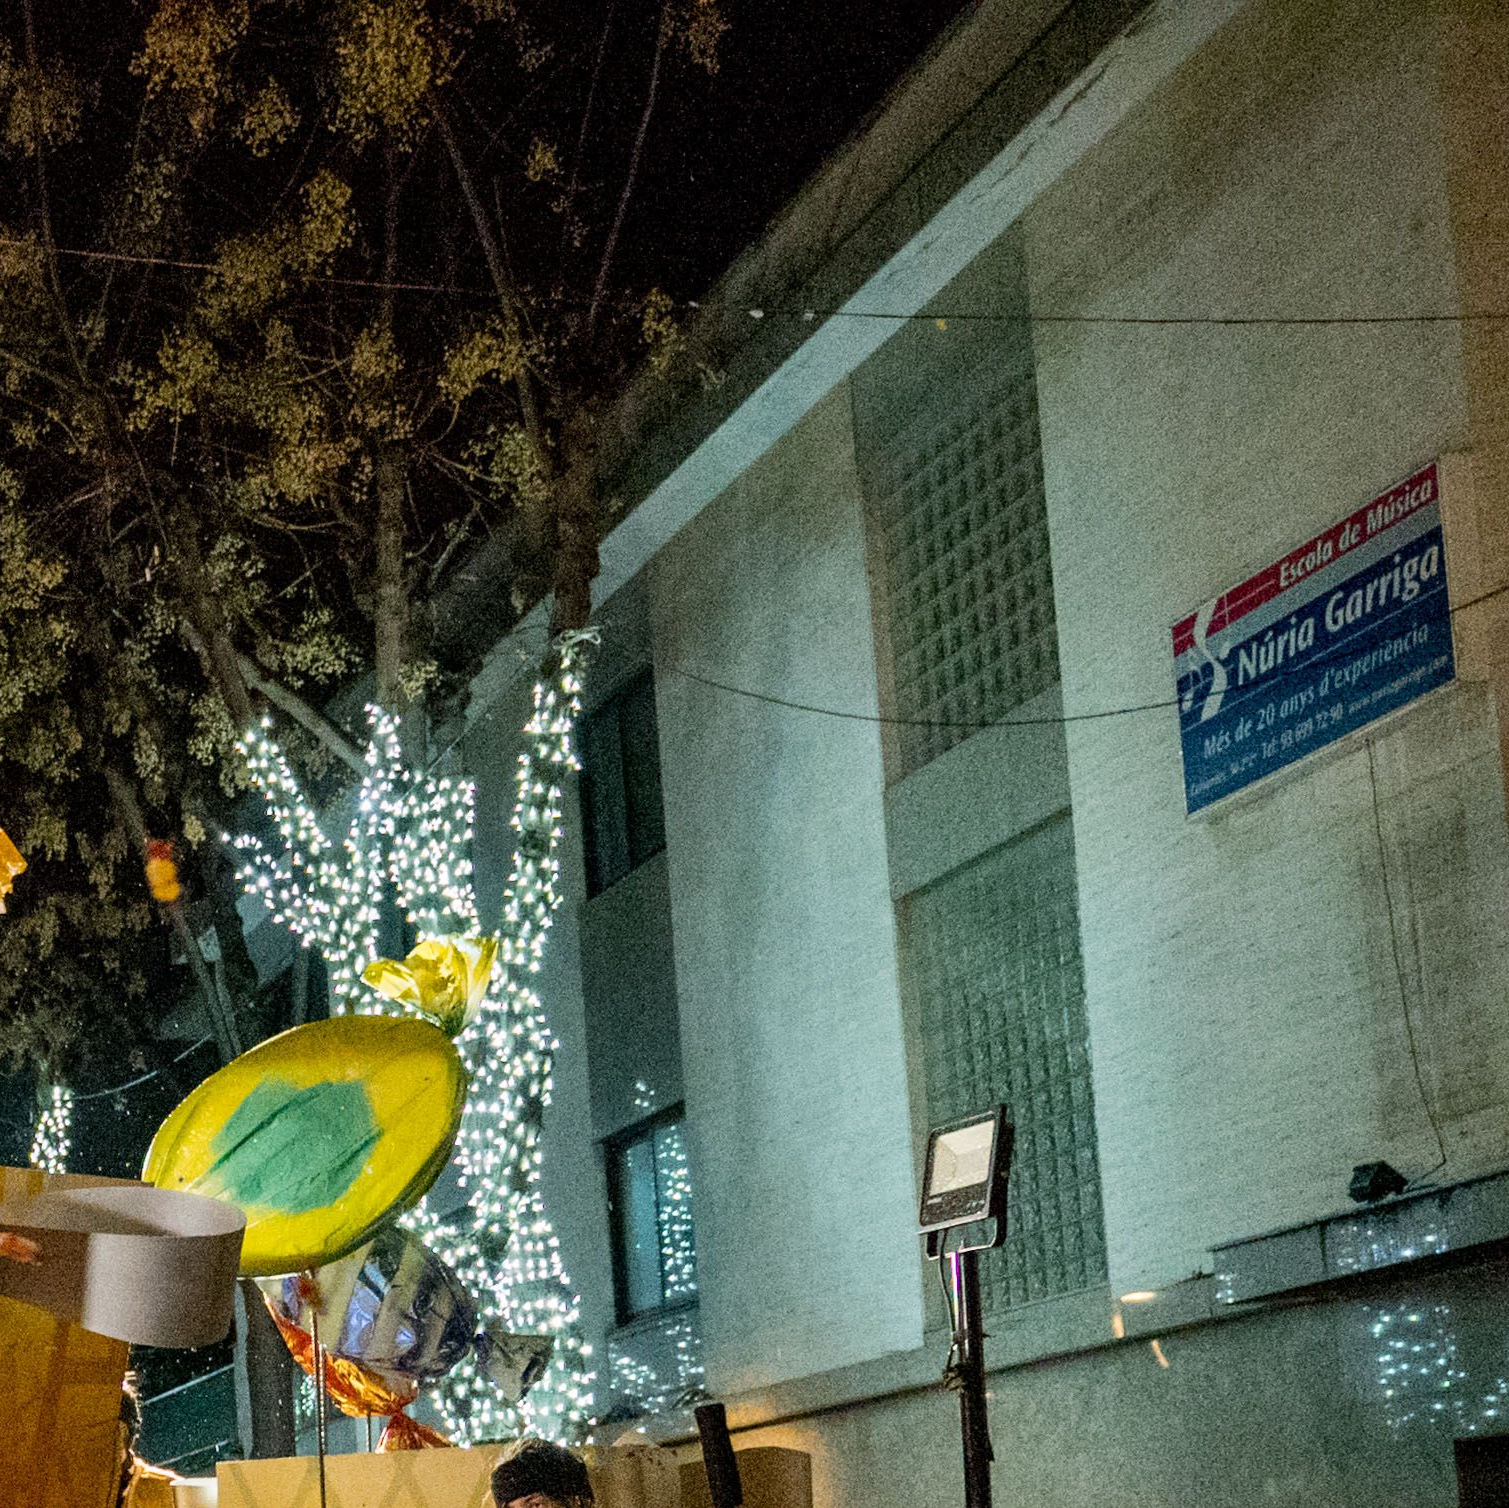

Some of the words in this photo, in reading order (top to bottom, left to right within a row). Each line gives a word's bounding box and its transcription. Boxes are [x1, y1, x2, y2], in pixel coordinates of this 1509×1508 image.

[1280, 540, 1332, 587] Escola
[1339, 521, 1361, 550] de
[1366, 479, 1431, 536] Música
[1238, 615, 1315, 686] Núria
[1325, 546, 1439, 633] Garriga
[1203, 729, 1232, 760] Més
[1235, 717, 1253, 743] de
[1256, 702, 1275, 731] 20
[1280, 685, 1315, 719] anys
